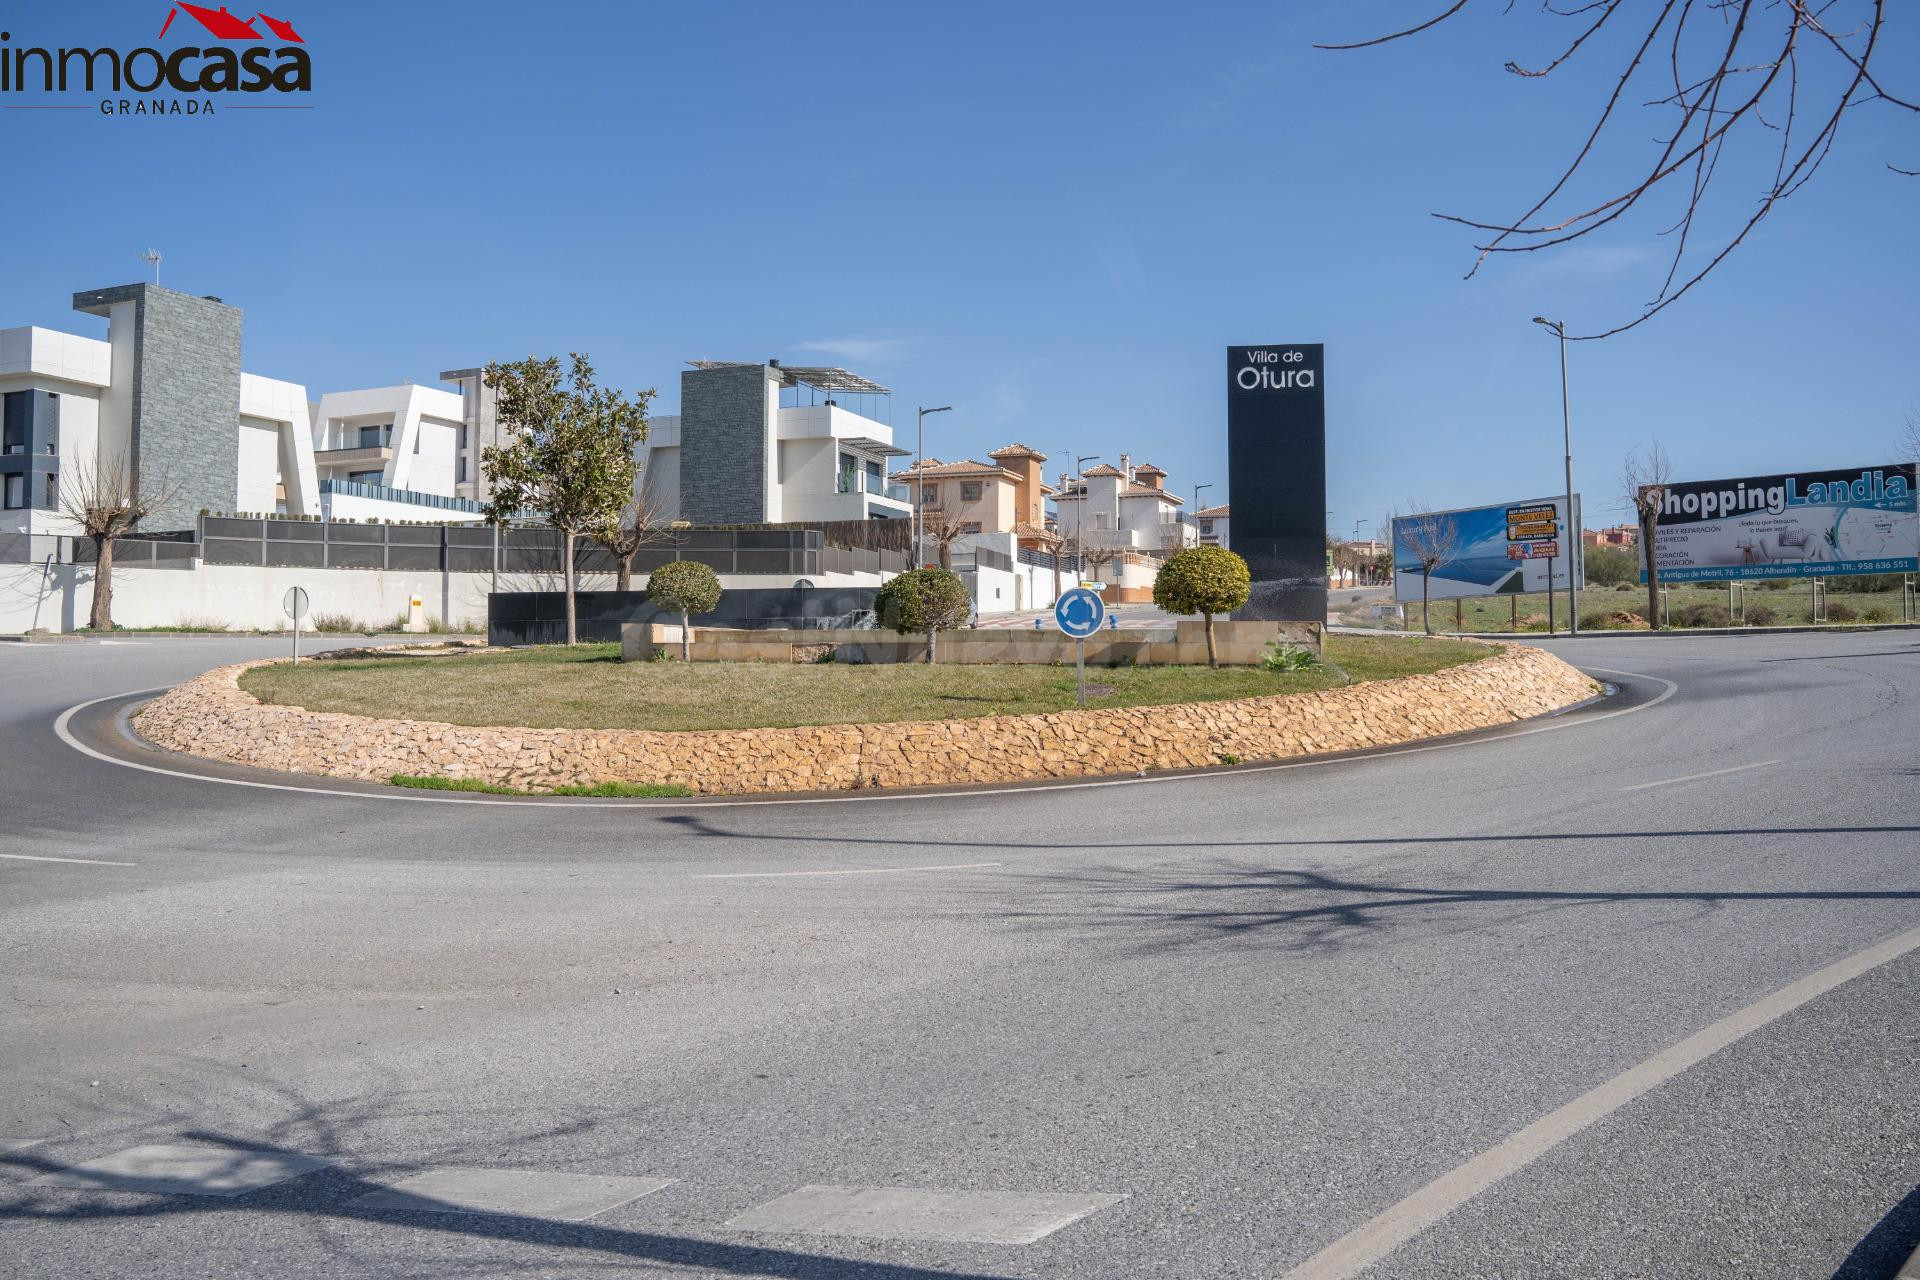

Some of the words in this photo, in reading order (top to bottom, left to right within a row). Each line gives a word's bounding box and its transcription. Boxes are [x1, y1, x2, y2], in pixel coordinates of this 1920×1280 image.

[1247, 350, 1278, 363] Villa
[1282, 349, 1304, 362] de
[1237, 366, 1315, 389] Otura
[1655, 551, 1689, 559] CORACIÓN
[1663, 571, 1690, 579] Antigua
[1690, 570, 1699, 578] de
[1741, 568, 1763, 576] 18620
[1803, 564, 1835, 573] Granada
[1857, 562, 1874, 570] 958
[1875, 561, 1891, 569] 636
[1893, 560, 1909, 568] 551
